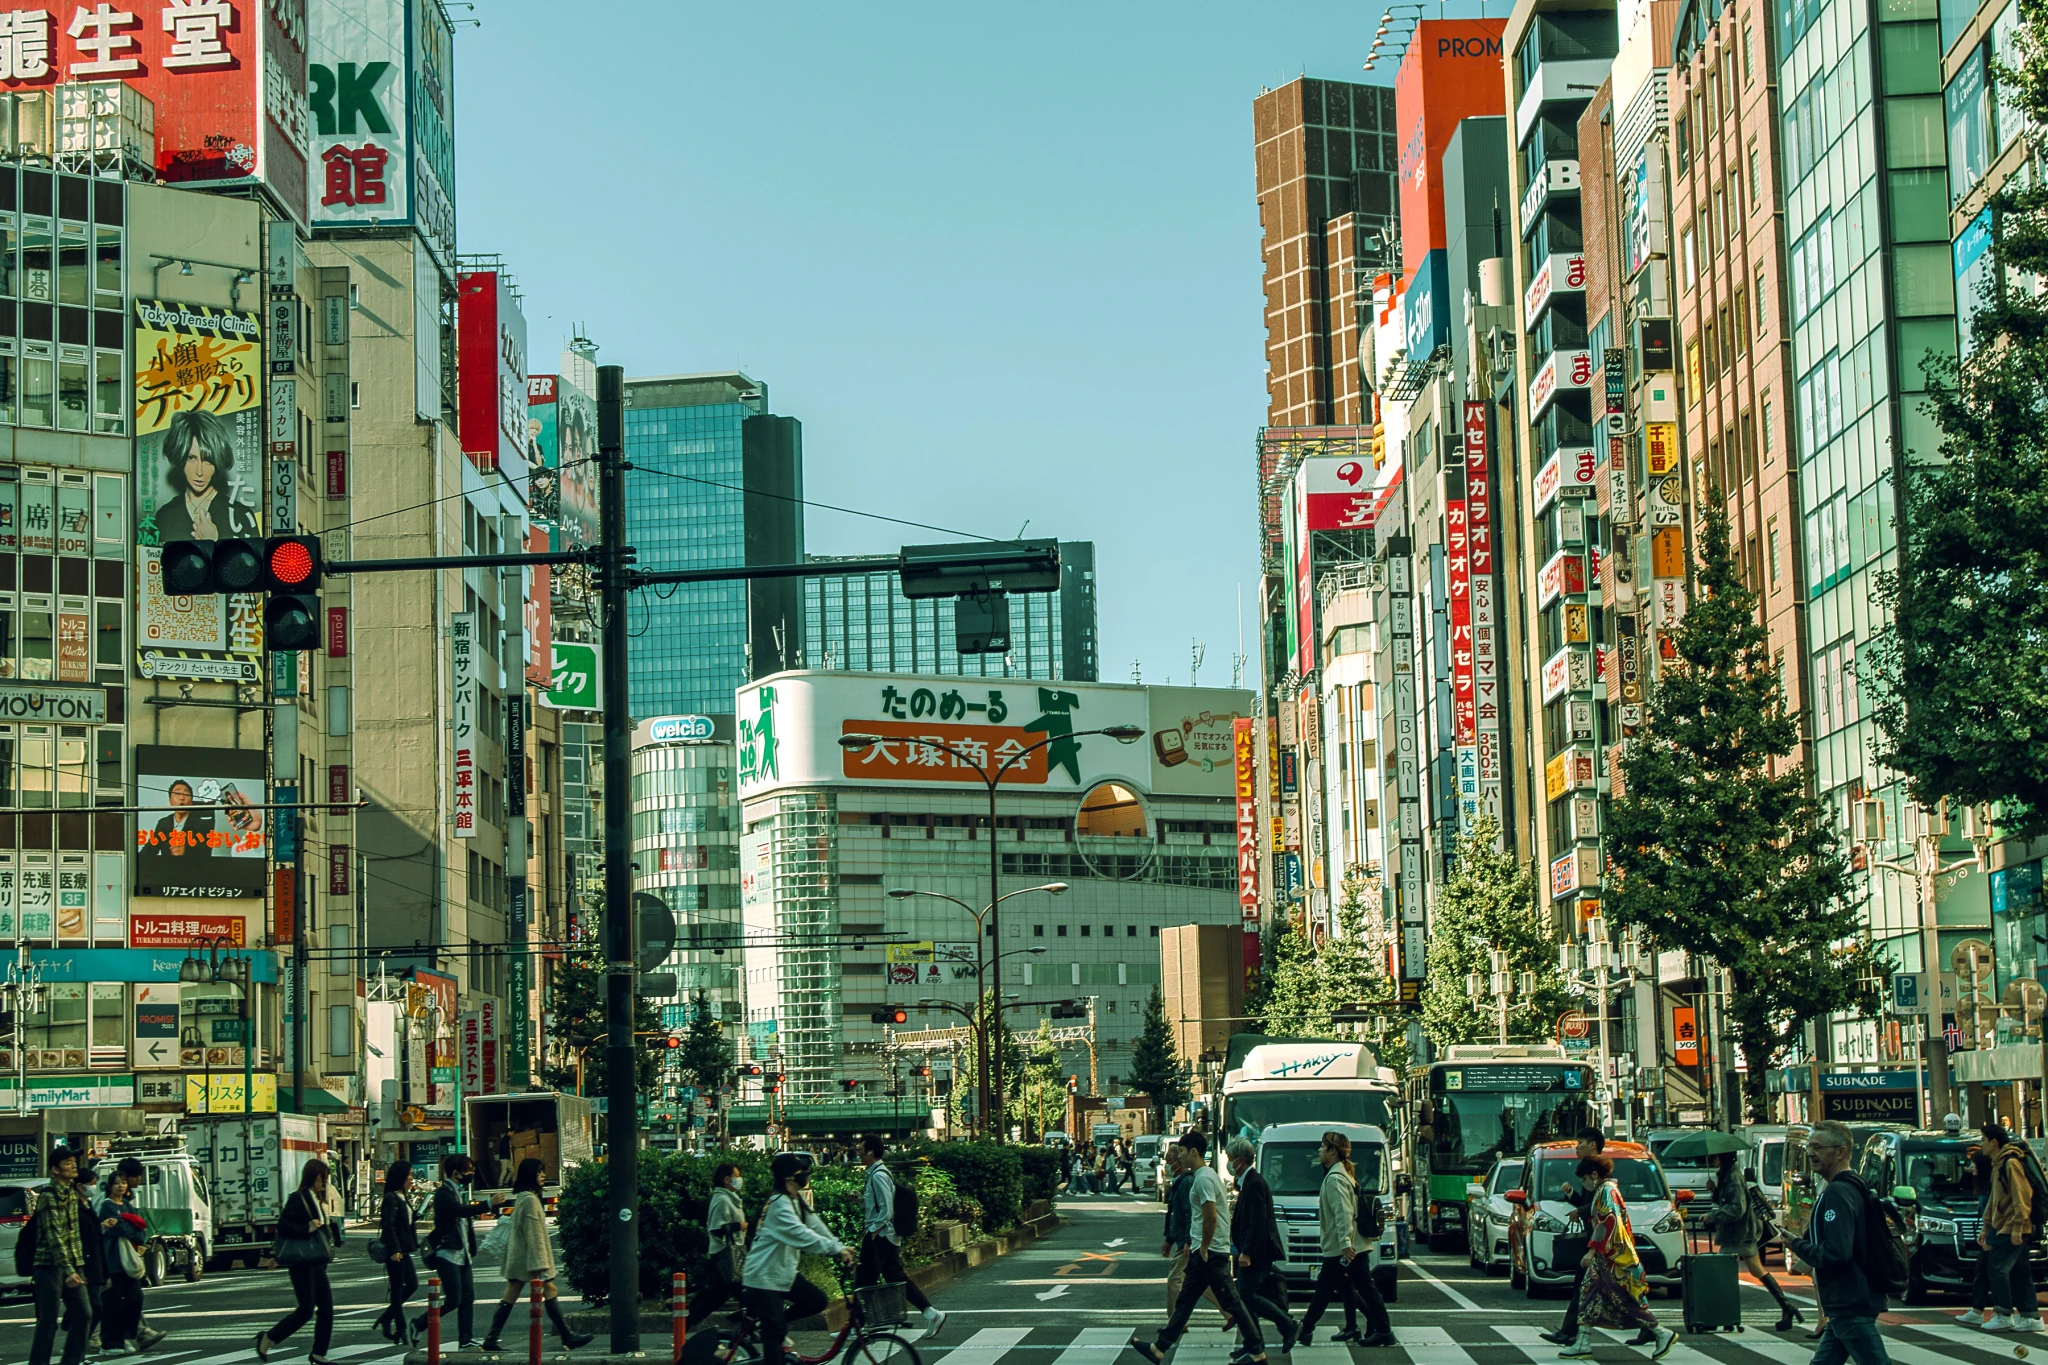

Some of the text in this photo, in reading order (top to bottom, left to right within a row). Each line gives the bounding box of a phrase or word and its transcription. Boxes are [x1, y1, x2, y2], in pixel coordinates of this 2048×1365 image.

[0, 0, 231, 80] 龍生堂
[321, 144, 388, 208] 館
[1520, 164, 1548, 232] DARTS
[30, 271, 49, 298] 碁
[141, 304, 256, 335] Tokyo Tensei Clinic
[275, 319, 290, 358] 相席屋
[150, 339, 200, 373] 小顔
[276, 362, 290, 371] 6F
[175, 356, 244, 388] 整形なら
[273, 383, 288, 438] パムッカレ
[236, 413, 246, 472] 美容外科医
[275, 443, 292, 452] 5F
[1466, 406, 1485, 468] パセラ
[1650, 425, 1666, 472] 千里香
[277, 463, 292, 529] MOUTON
[1651, 504, 1674, 512] Darts
[138, 499, 158, 530] 日本
[1469, 479, 1490, 567] カラオケ
[1656, 512, 1680, 524] UP
[1449, 508, 1468, 598] カラオケ
[1662, 531, 1673, 574] 駄菓子バー
[1395, 559, 1403, 590] 6年4組
[60, 618, 86, 630] トルコ
[1396, 602, 1405, 630] おかか
[62, 630, 84, 642] 料理
[331, 614, 344, 651] partir
[61, 661, 87, 670] TURKISH
[159, 662, 239, 675] テンクリ たいせい先生
[1453, 624, 1472, 692] パセラ
[881, 685, 1009, 724] たのめーる
[1465, 701, 1474, 719] 名物
[454, 621, 473, 829] 新宿サンパーク 三平本館
[654, 720, 707, 739] welcia
[1194, 732, 1234, 741] ITでオフィス
[1282, 705, 1292, 741] 戸谷ビル
[1398, 678, 1412, 793] KIBORI
[1577, 731, 1588, 739] 5F
[1193, 743, 1228, 751] 元気にする
[1480, 733, 1491, 779] 300名
[1490, 733, 1499, 779] 地域最大級
[1236, 729, 1252, 797] パチンコ
[1286, 755, 1294, 784] PROMISE
[1460, 749, 1475, 794] 大画面
[1239, 802, 1257, 897] エスパス
[333, 855, 345, 882] 龍生堂
[65, 894, 83, 905] 3F
[162, 886, 243, 898] リアエイド ビジョン
[135, 919, 229, 936] トルコ料理 パムッカレ
[1410, 930, 1420, 976] ミステリアス
[1898, 996, 1916, 1005] 7-20
[1901, 978, 1913, 996] P
[139, 1015, 175, 1024] PROMISE
[465, 1018, 479, 1087] 三平ストア
[31, 1089, 91, 1104] amilyMart
[142, 1082, 172, 1098] 囲碁
[1826, 1075, 1887, 1087] SUBNADE
[1832, 1097, 1914, 1112] SUBNADE
